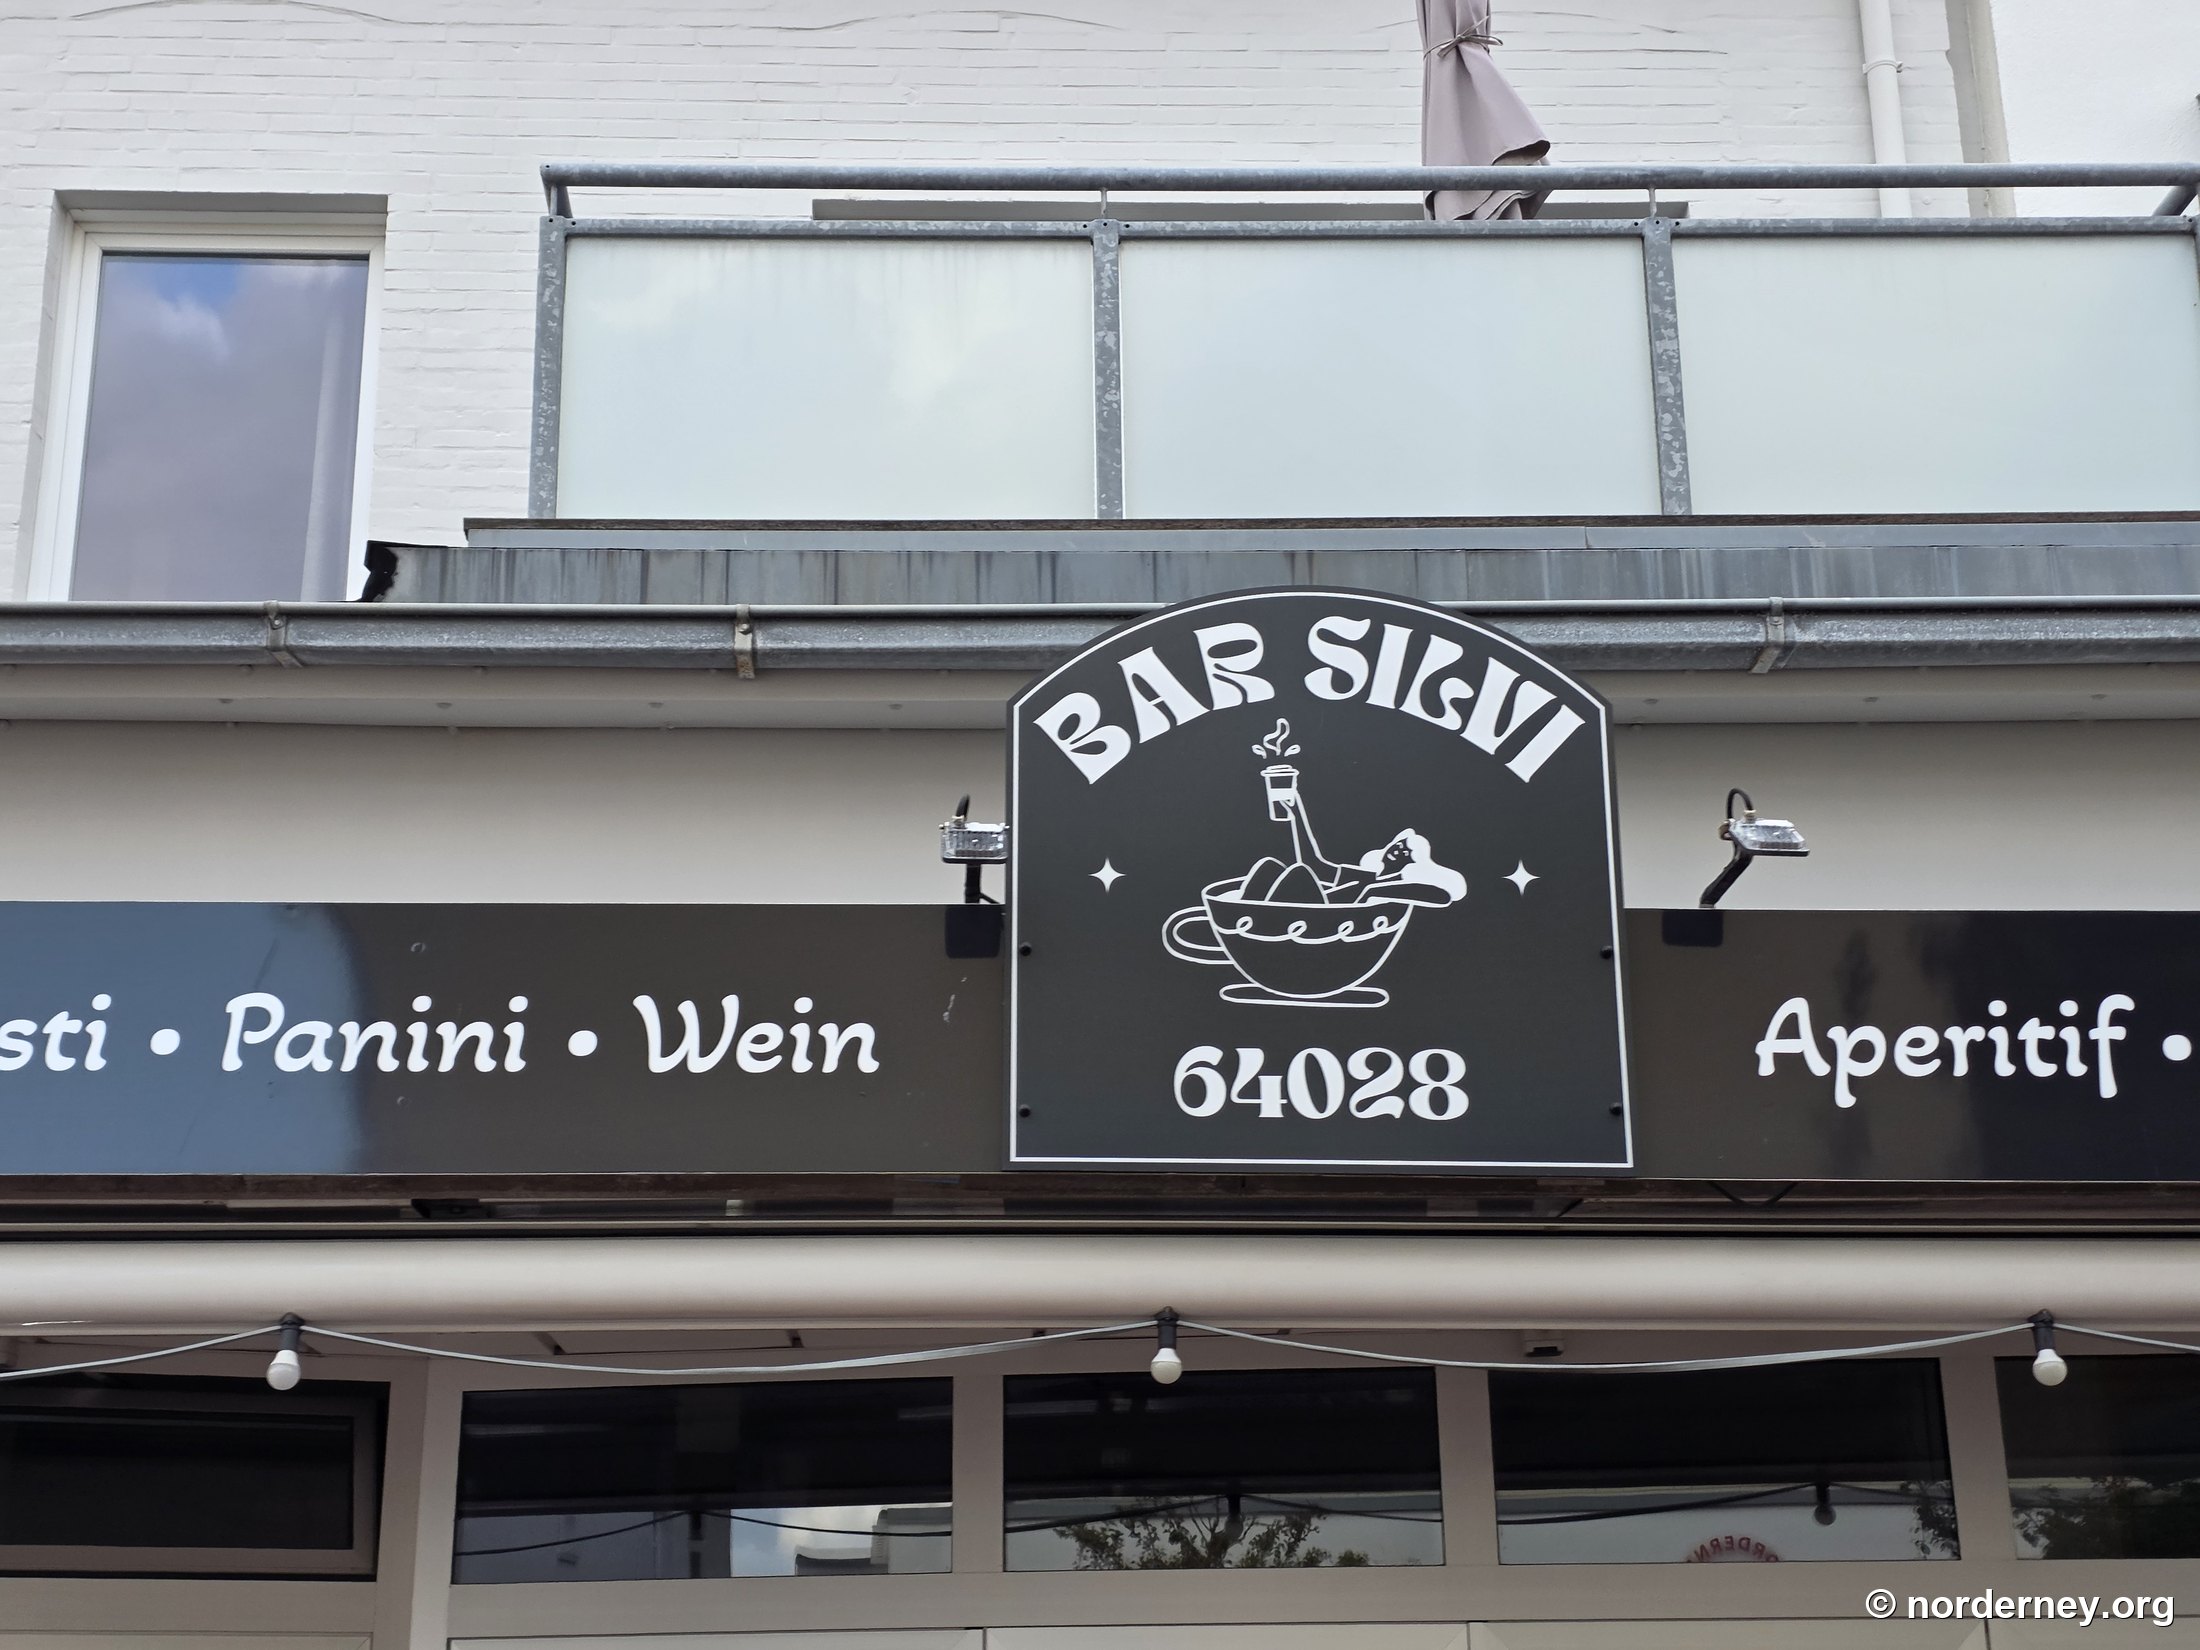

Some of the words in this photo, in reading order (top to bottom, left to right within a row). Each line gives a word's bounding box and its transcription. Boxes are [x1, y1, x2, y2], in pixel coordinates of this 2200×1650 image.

[1033, 622, 1275, 785] BAR
[1304, 615, 1586, 783] SILVI
[0, 993, 112, 1072] sti
[221, 992, 529, 1073] Panini
[632, 994, 880, 1074] Wein
[1755, 993, 2135, 1109] Aperitif
[1173, 1045, 1469, 1121] 64028
